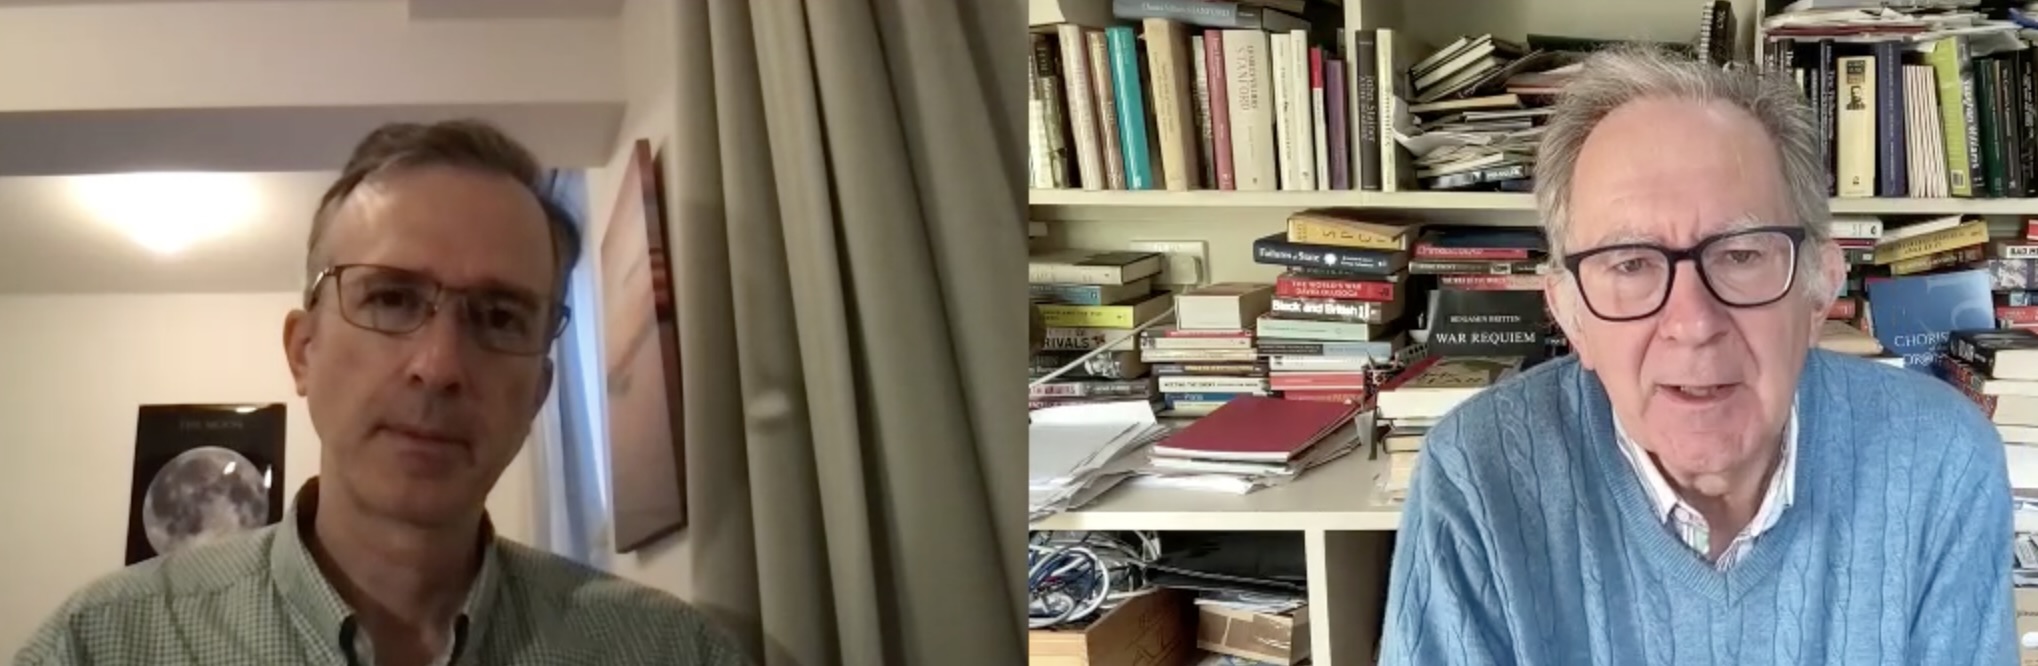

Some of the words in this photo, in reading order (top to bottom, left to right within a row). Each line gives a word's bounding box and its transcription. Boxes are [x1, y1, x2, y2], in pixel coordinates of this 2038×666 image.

[1236, 46, 1250, 111] STANFORD
[1365, 75, 1374, 102] John
[1962, 78, 1976, 123] Vaughan
[1367, 104, 1377, 143] Stainer
[1967, 124, 1980, 169] Williams
[1298, 251, 1320, 263] State
[1272, 299, 1302, 312] Black
[1303, 301, 1323, 314] and
[1324, 303, 1358, 316] British
[1450, 315, 1488, 323] BENJAMIN
[1044, 337, 1090, 349] RIVALS
[1436, 332, 1466, 344] WAR
[1471, 331, 1537, 346] REQUIEM
